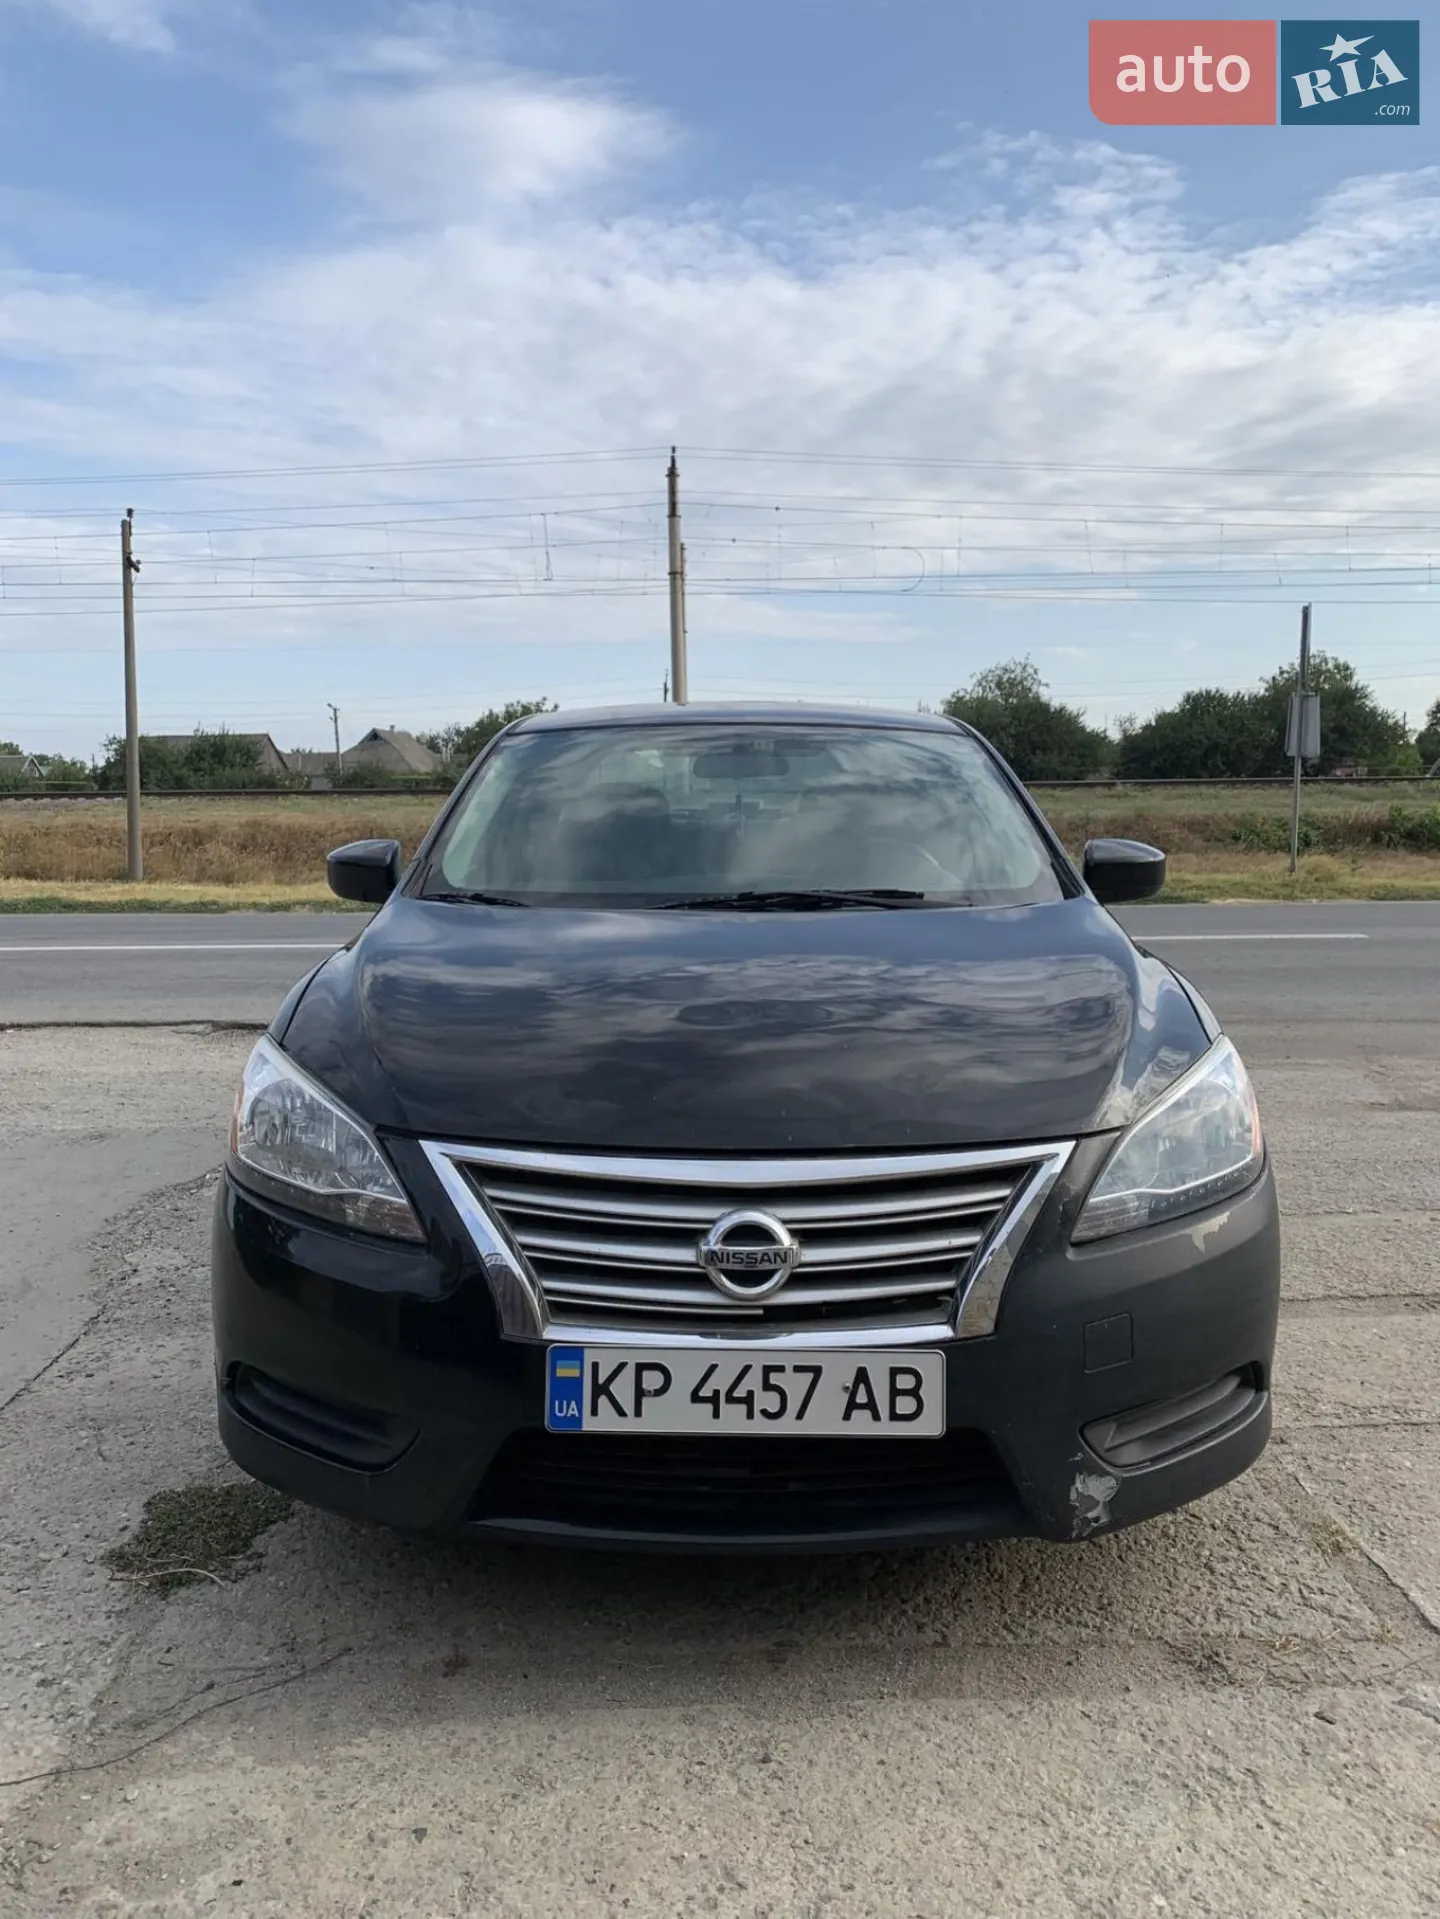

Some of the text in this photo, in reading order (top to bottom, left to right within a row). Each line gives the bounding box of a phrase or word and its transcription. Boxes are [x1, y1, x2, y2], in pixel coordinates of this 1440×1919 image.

[710, 1251, 787, 1265] NISSAN
[589, 1360, 925, 1422] KP 4457 AB
[555, 1400, 579, 1417] UA
